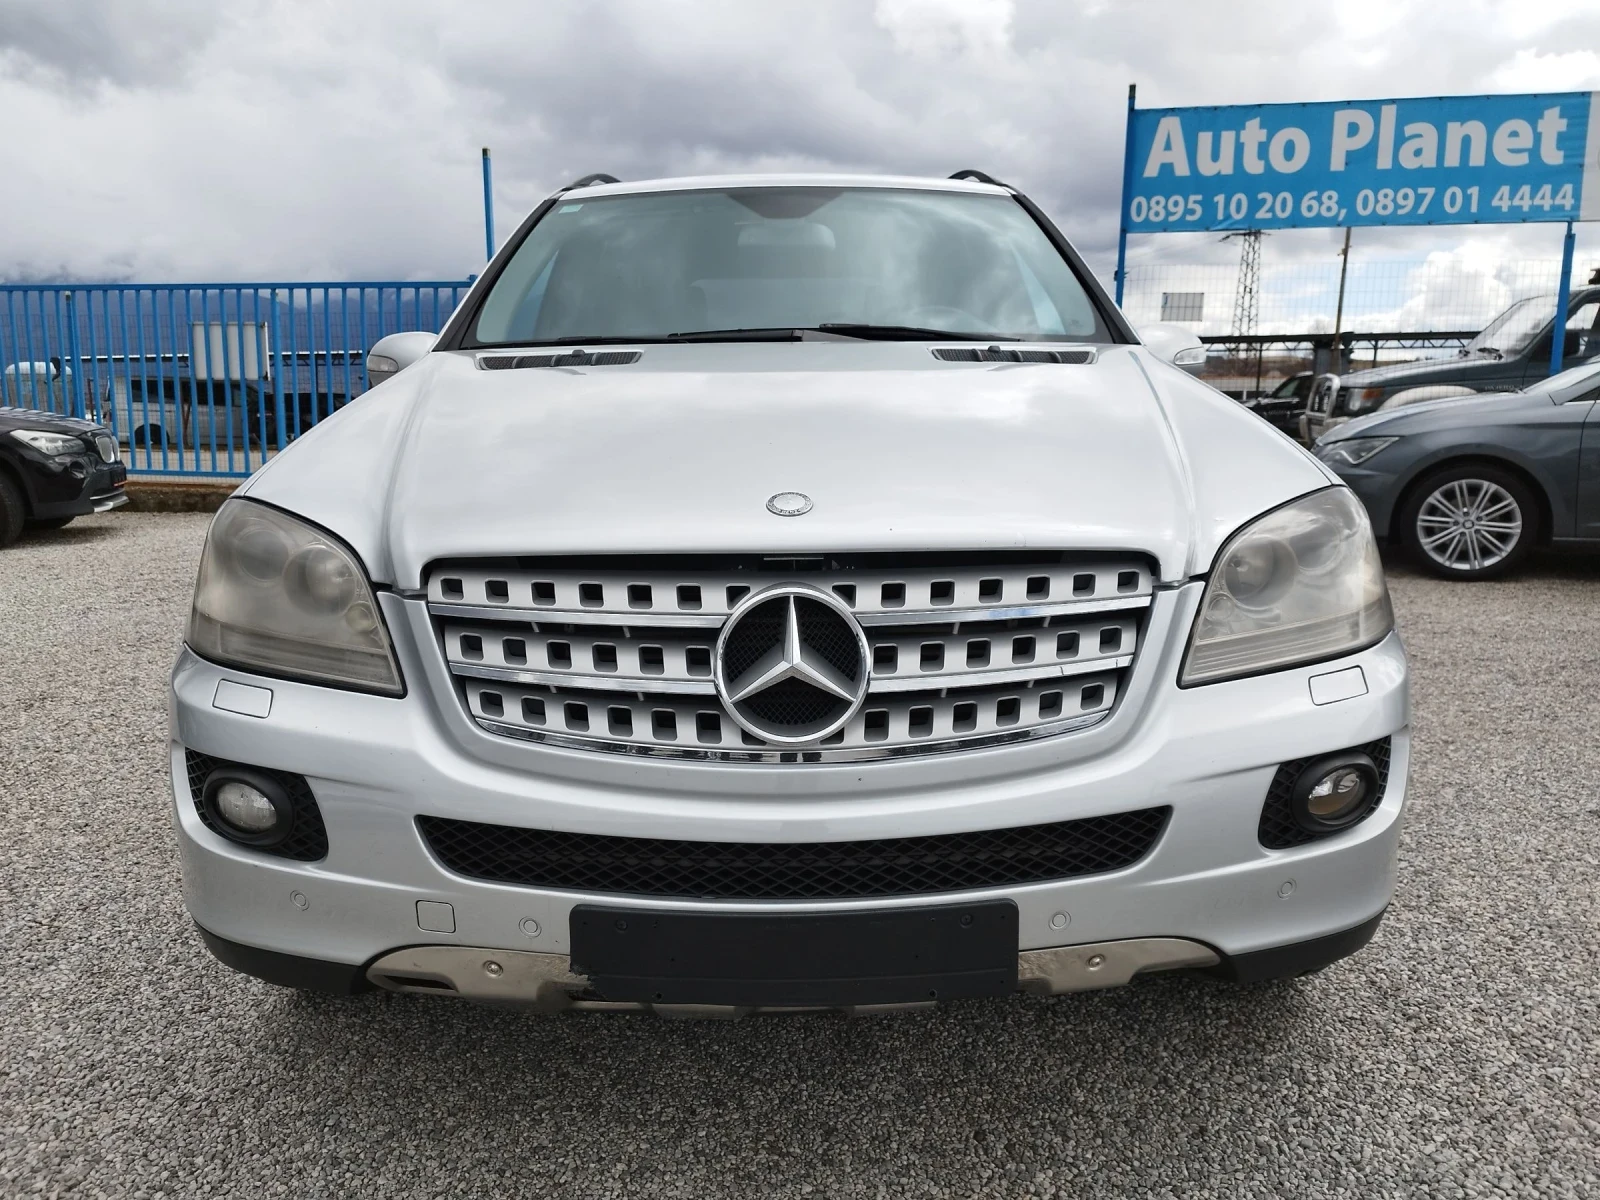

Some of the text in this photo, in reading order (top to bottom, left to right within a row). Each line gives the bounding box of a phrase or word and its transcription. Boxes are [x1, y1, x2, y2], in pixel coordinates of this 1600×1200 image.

[1143, 105, 1568, 177] Auto Planet
[1130, 184, 1575, 222] 0895 10 20 68, 0897 01 4444
